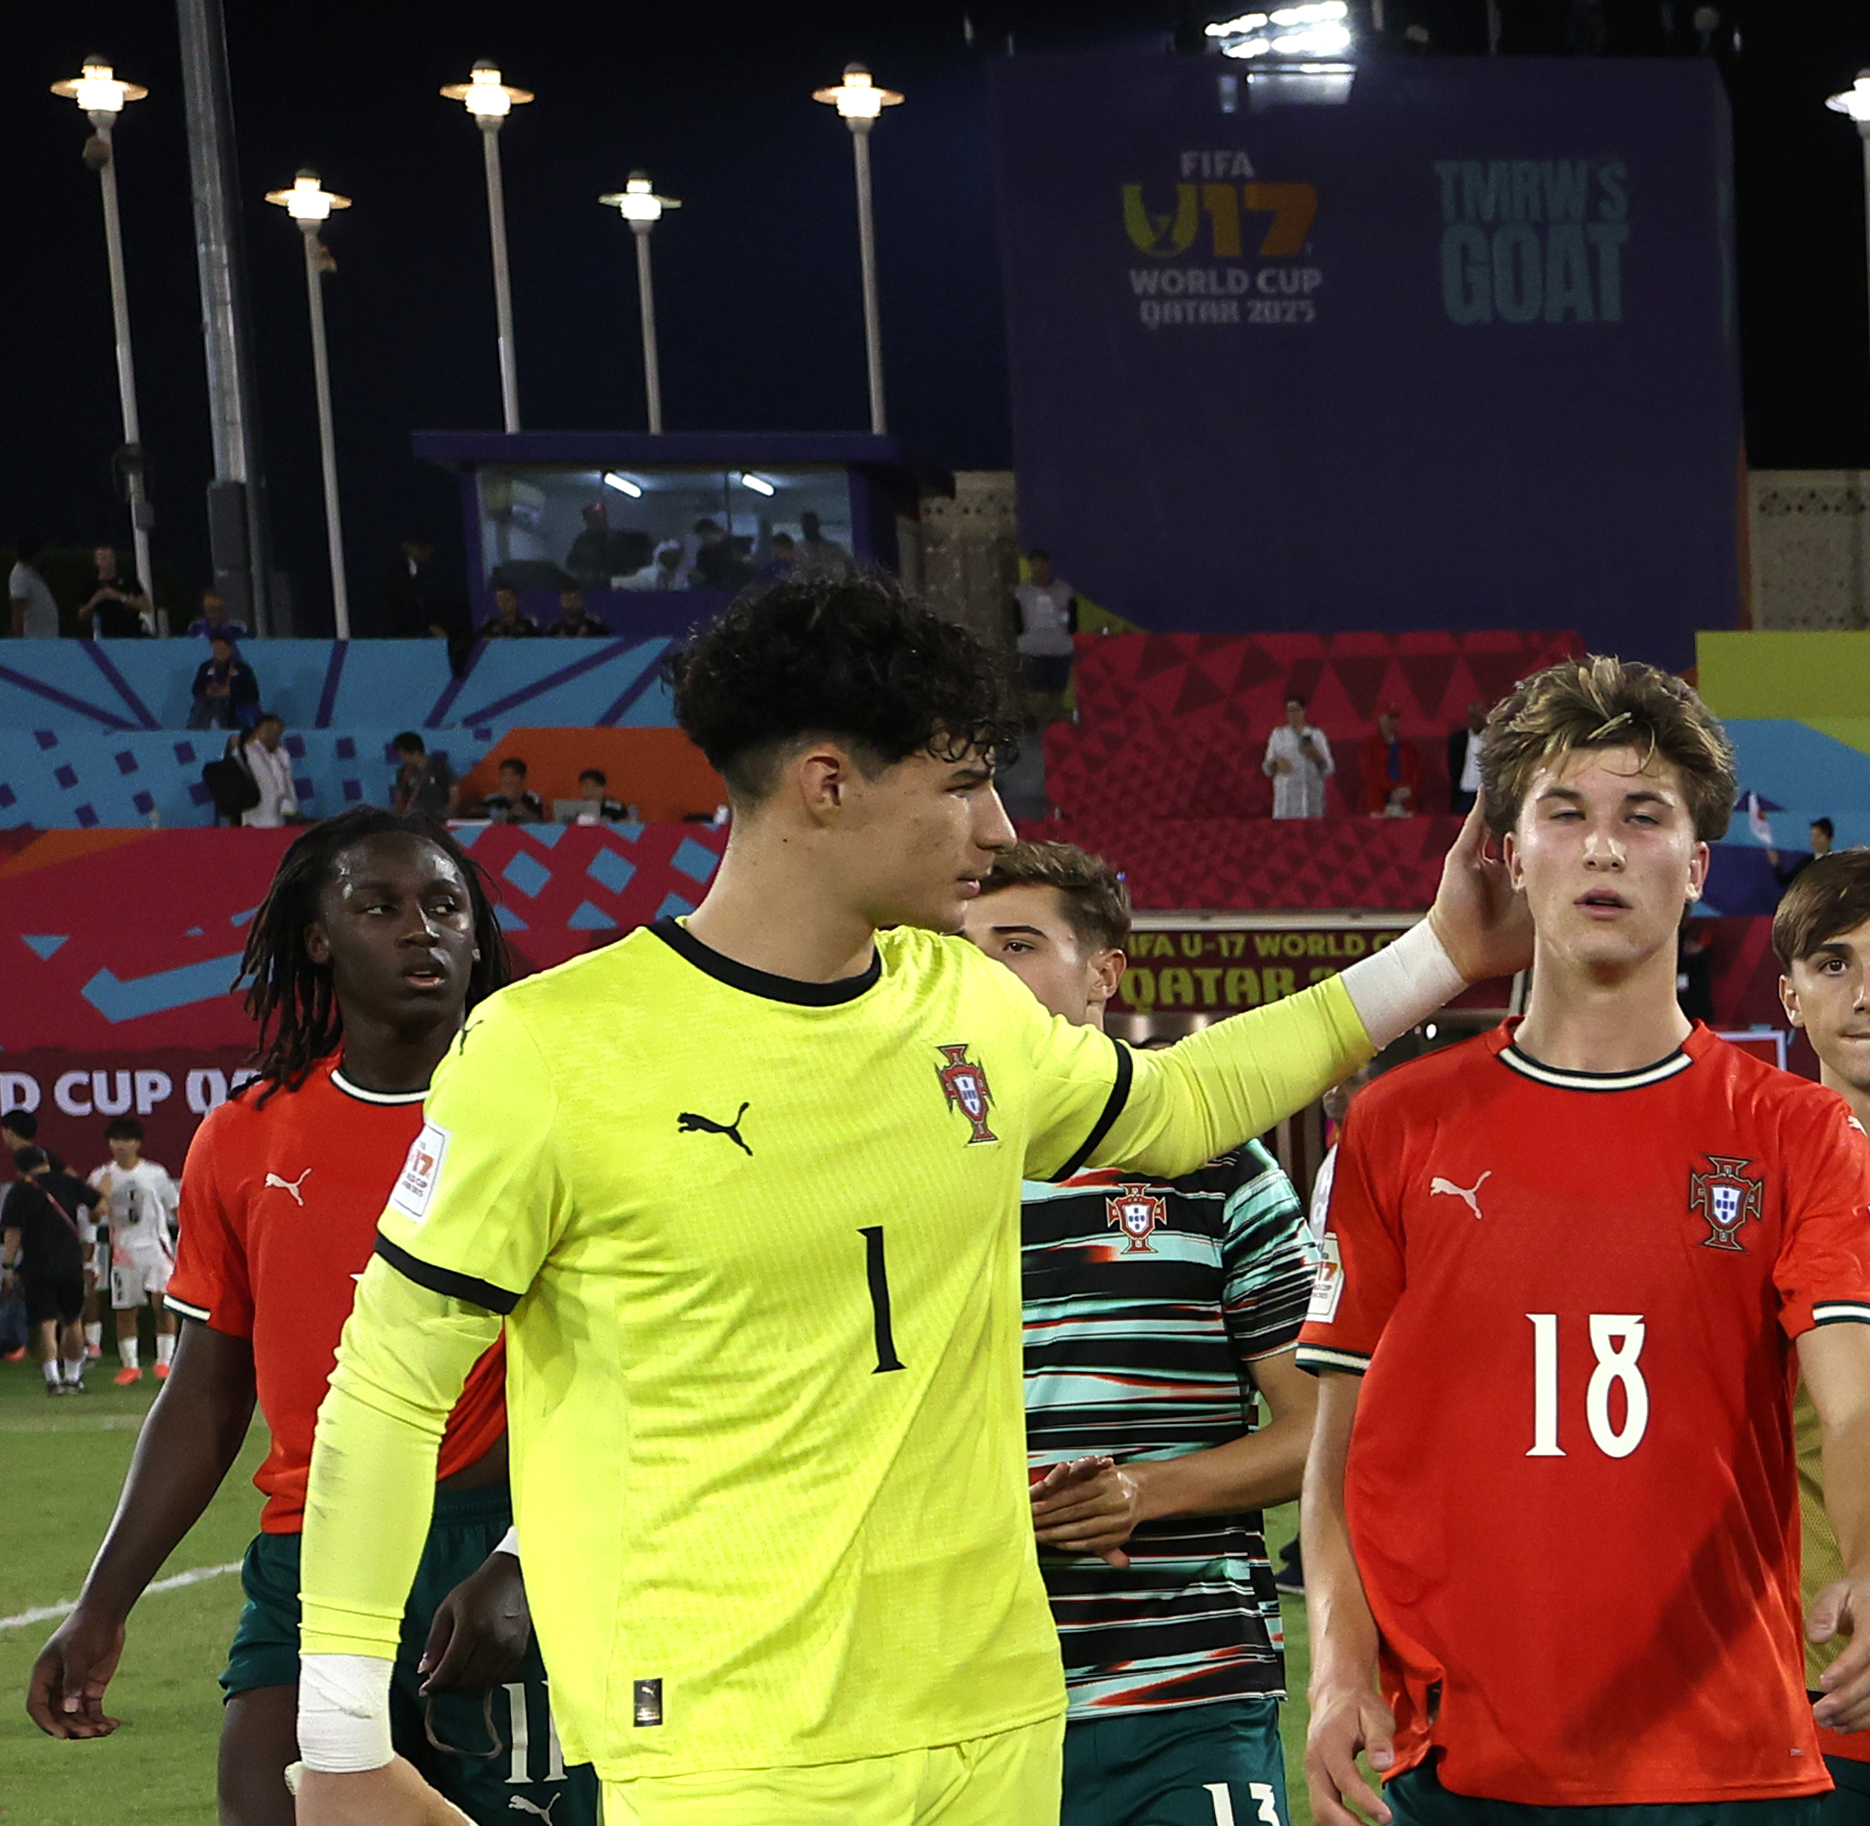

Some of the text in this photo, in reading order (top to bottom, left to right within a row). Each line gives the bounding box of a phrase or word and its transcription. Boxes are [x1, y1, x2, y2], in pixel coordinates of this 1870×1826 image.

[1180, 150, 1255, 179] FIFA
[1121, 182, 1320, 258] U17
[1129, 267, 1323, 296] WORLD CUP
[1440, 221, 1630, 324] GOAT
[1139, 299, 1316, 330] QATAR 2025
[1126, 933, 1174, 958] IFA
[1180, 933, 1247, 958] U-17
[1254, 932, 1365, 958] WORLD
[1119, 966, 1297, 1013] QATAR
[53, 1068, 173, 1117] CUP
[857, 1225, 908, 1375] 1
[1524, 1313, 1650, 1459] 18
